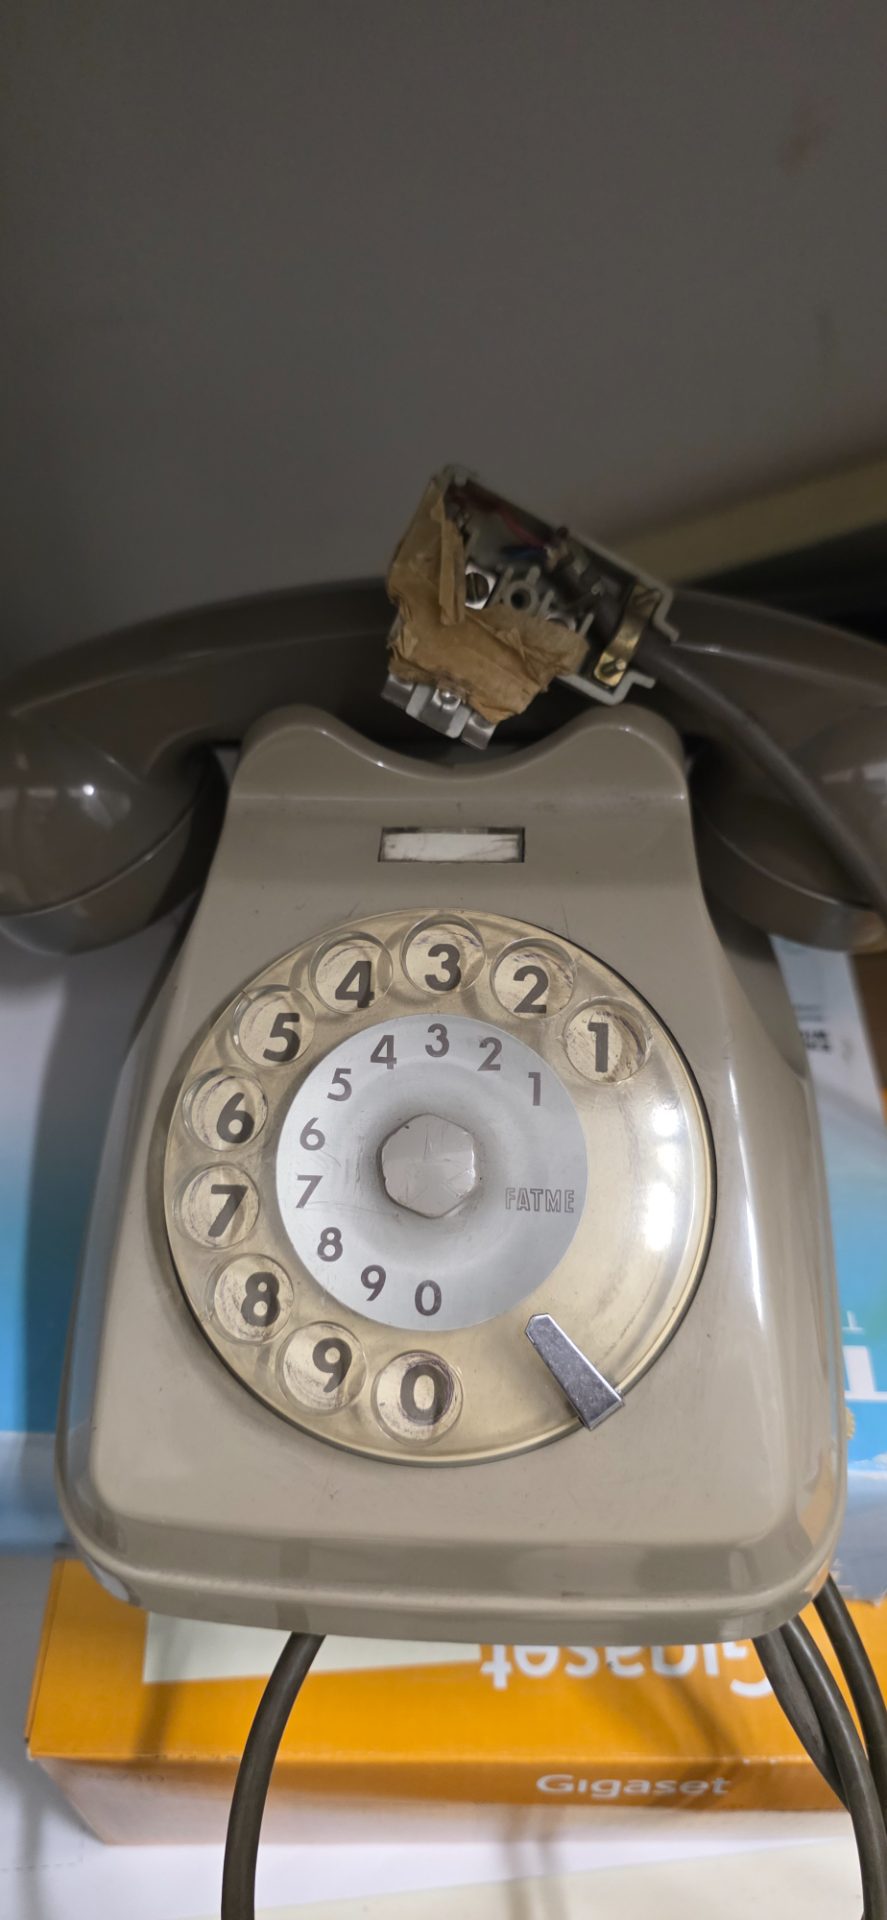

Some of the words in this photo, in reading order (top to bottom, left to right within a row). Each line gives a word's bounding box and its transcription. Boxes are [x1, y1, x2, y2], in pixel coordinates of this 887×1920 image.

[335, 960, 374, 1008] 4
[425, 943, 462, 991] 3
[512, 966, 549, 1014] 2
[263, 1013, 301, 1062] 5
[370, 1035, 397, 1070] 4
[425, 1024, 450, 1057] 3
[477, 1037, 502, 1071] 2
[588, 1022, 609, 1073] 1
[328, 1068, 353, 1102] 5
[528, 1072, 541, 1106] 1
[216, 1092, 254, 1144] 6
[300, 1118, 326, 1150] 6
[295, 1175, 323, 1209] 7
[505, 1187, 575, 1213] FATME
[208, 1184, 248, 1238] 7
[317, 1227, 343, 1262] 8
[241, 1272, 280, 1327] 8
[361, 1264, 387, 1301] 9
[414, 1280, 442, 1316] 0
[313, 1338, 352, 1393] 9
[400, 1365, 444, 1426] 0
[536, 1774, 733, 1799] Gigaset
